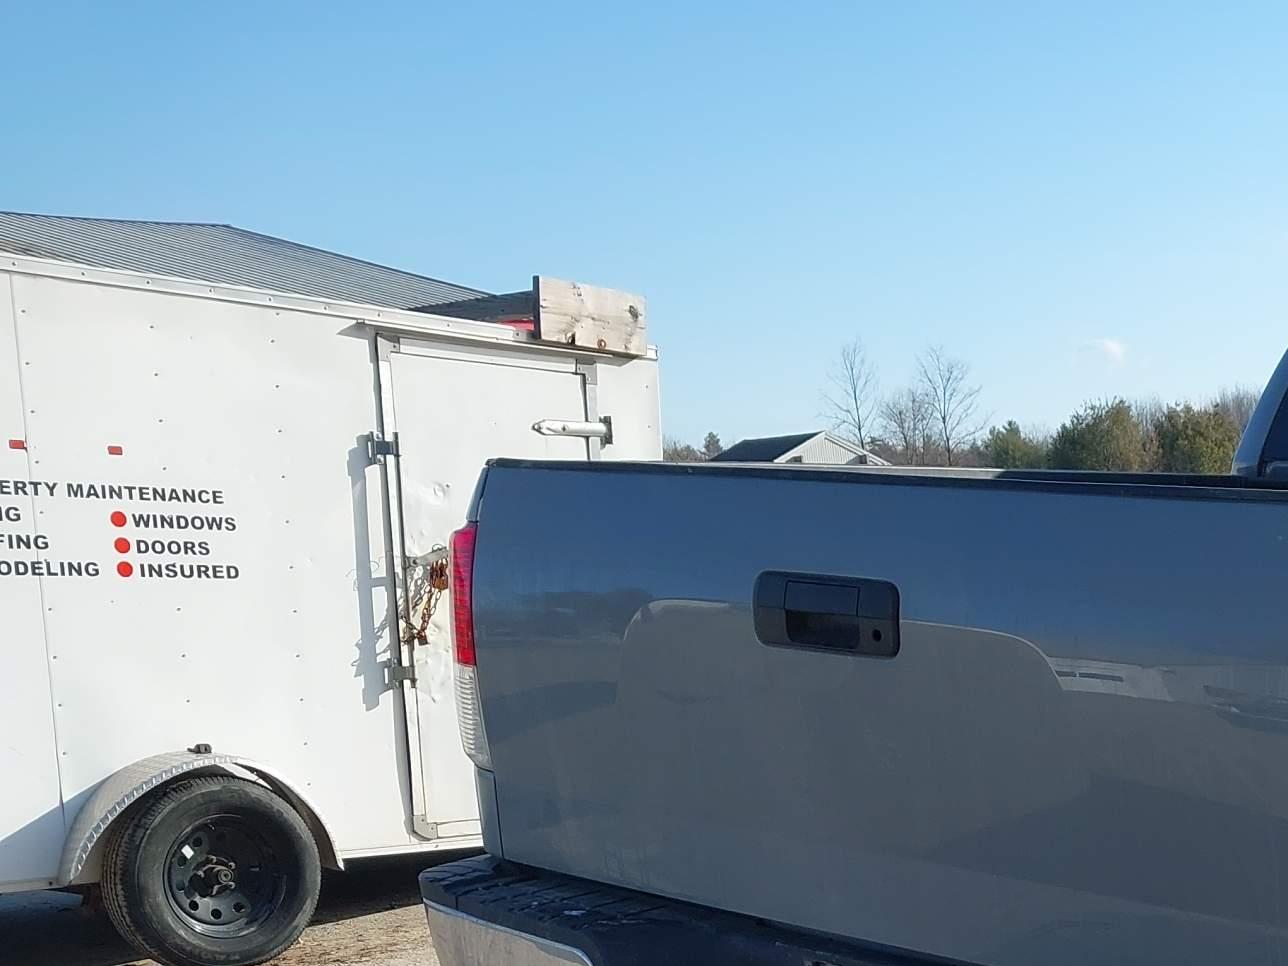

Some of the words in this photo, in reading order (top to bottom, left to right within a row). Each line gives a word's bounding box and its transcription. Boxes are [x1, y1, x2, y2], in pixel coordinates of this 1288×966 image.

[0, 480, 58, 497] ERTY
[66, 482, 225, 504] MAINTENANCE
[131, 513, 237, 532] WINDOWS
[135, 539, 211, 556] DOORS
[0, 560, 100, 577] ODELING
[139, 562, 240, 579] INSURED
